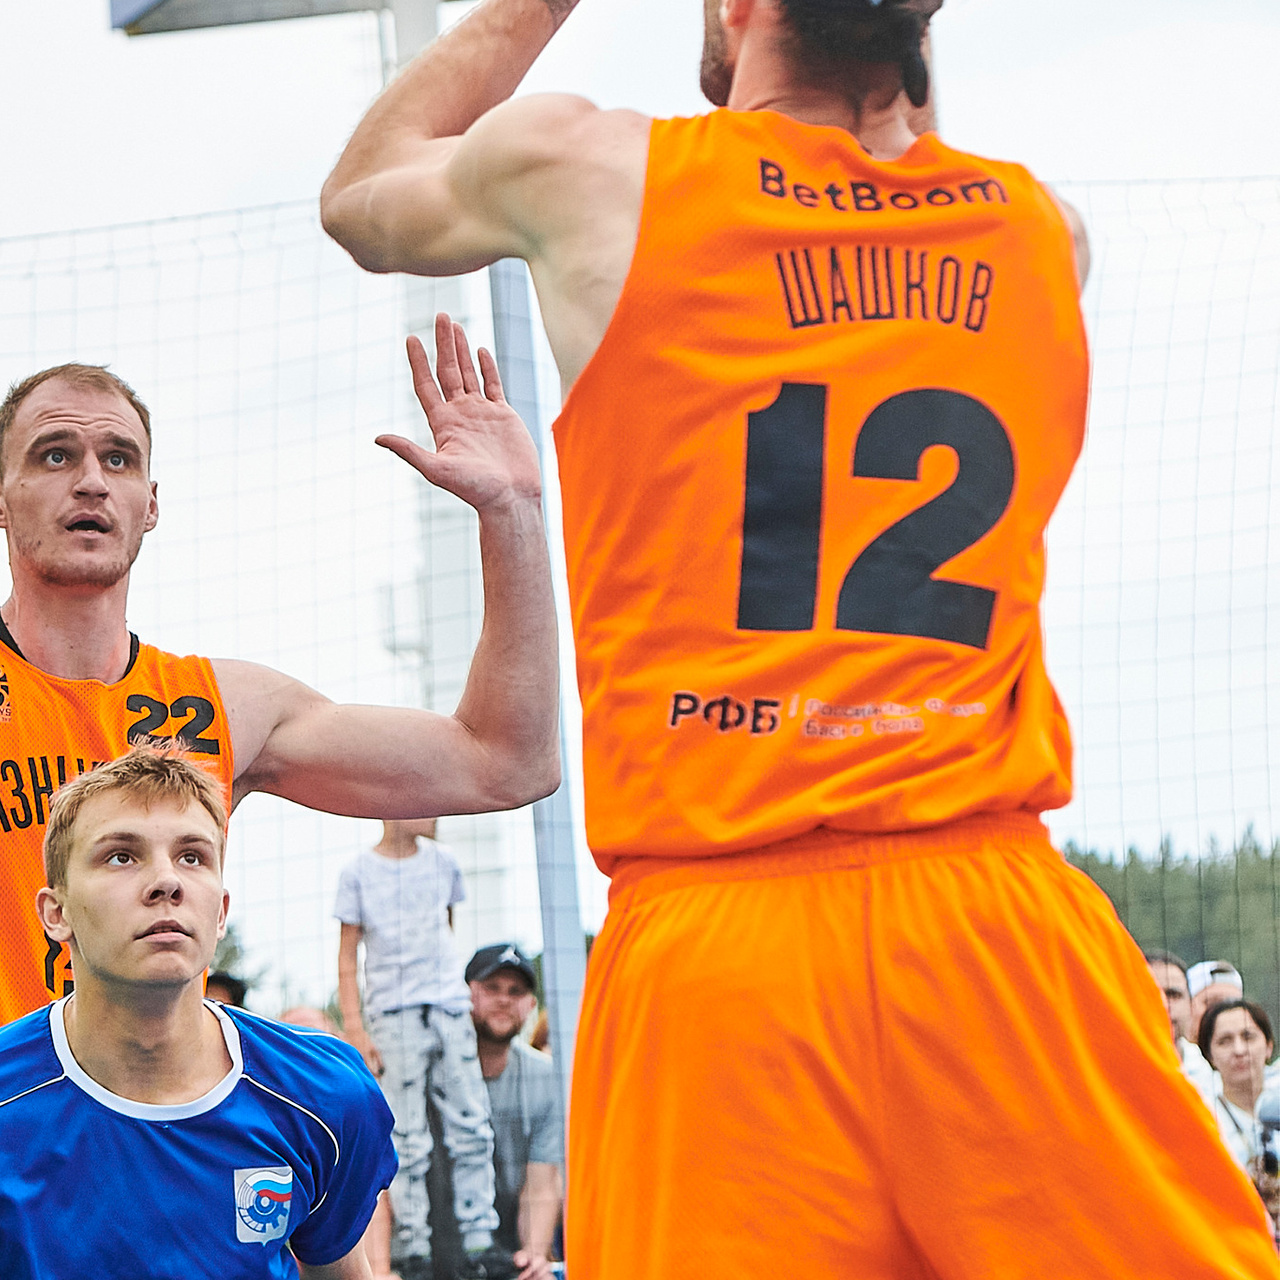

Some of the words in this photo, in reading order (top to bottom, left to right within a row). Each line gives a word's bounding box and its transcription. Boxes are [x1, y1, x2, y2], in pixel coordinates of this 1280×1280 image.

[758, 158, 1010, 213] BetBoom
[775, 246, 995, 333] ШАШКОВ
[736, 381, 1016, 651] 12
[126, 694, 220, 756] 22
[670, 693, 781, 735] РФБ
